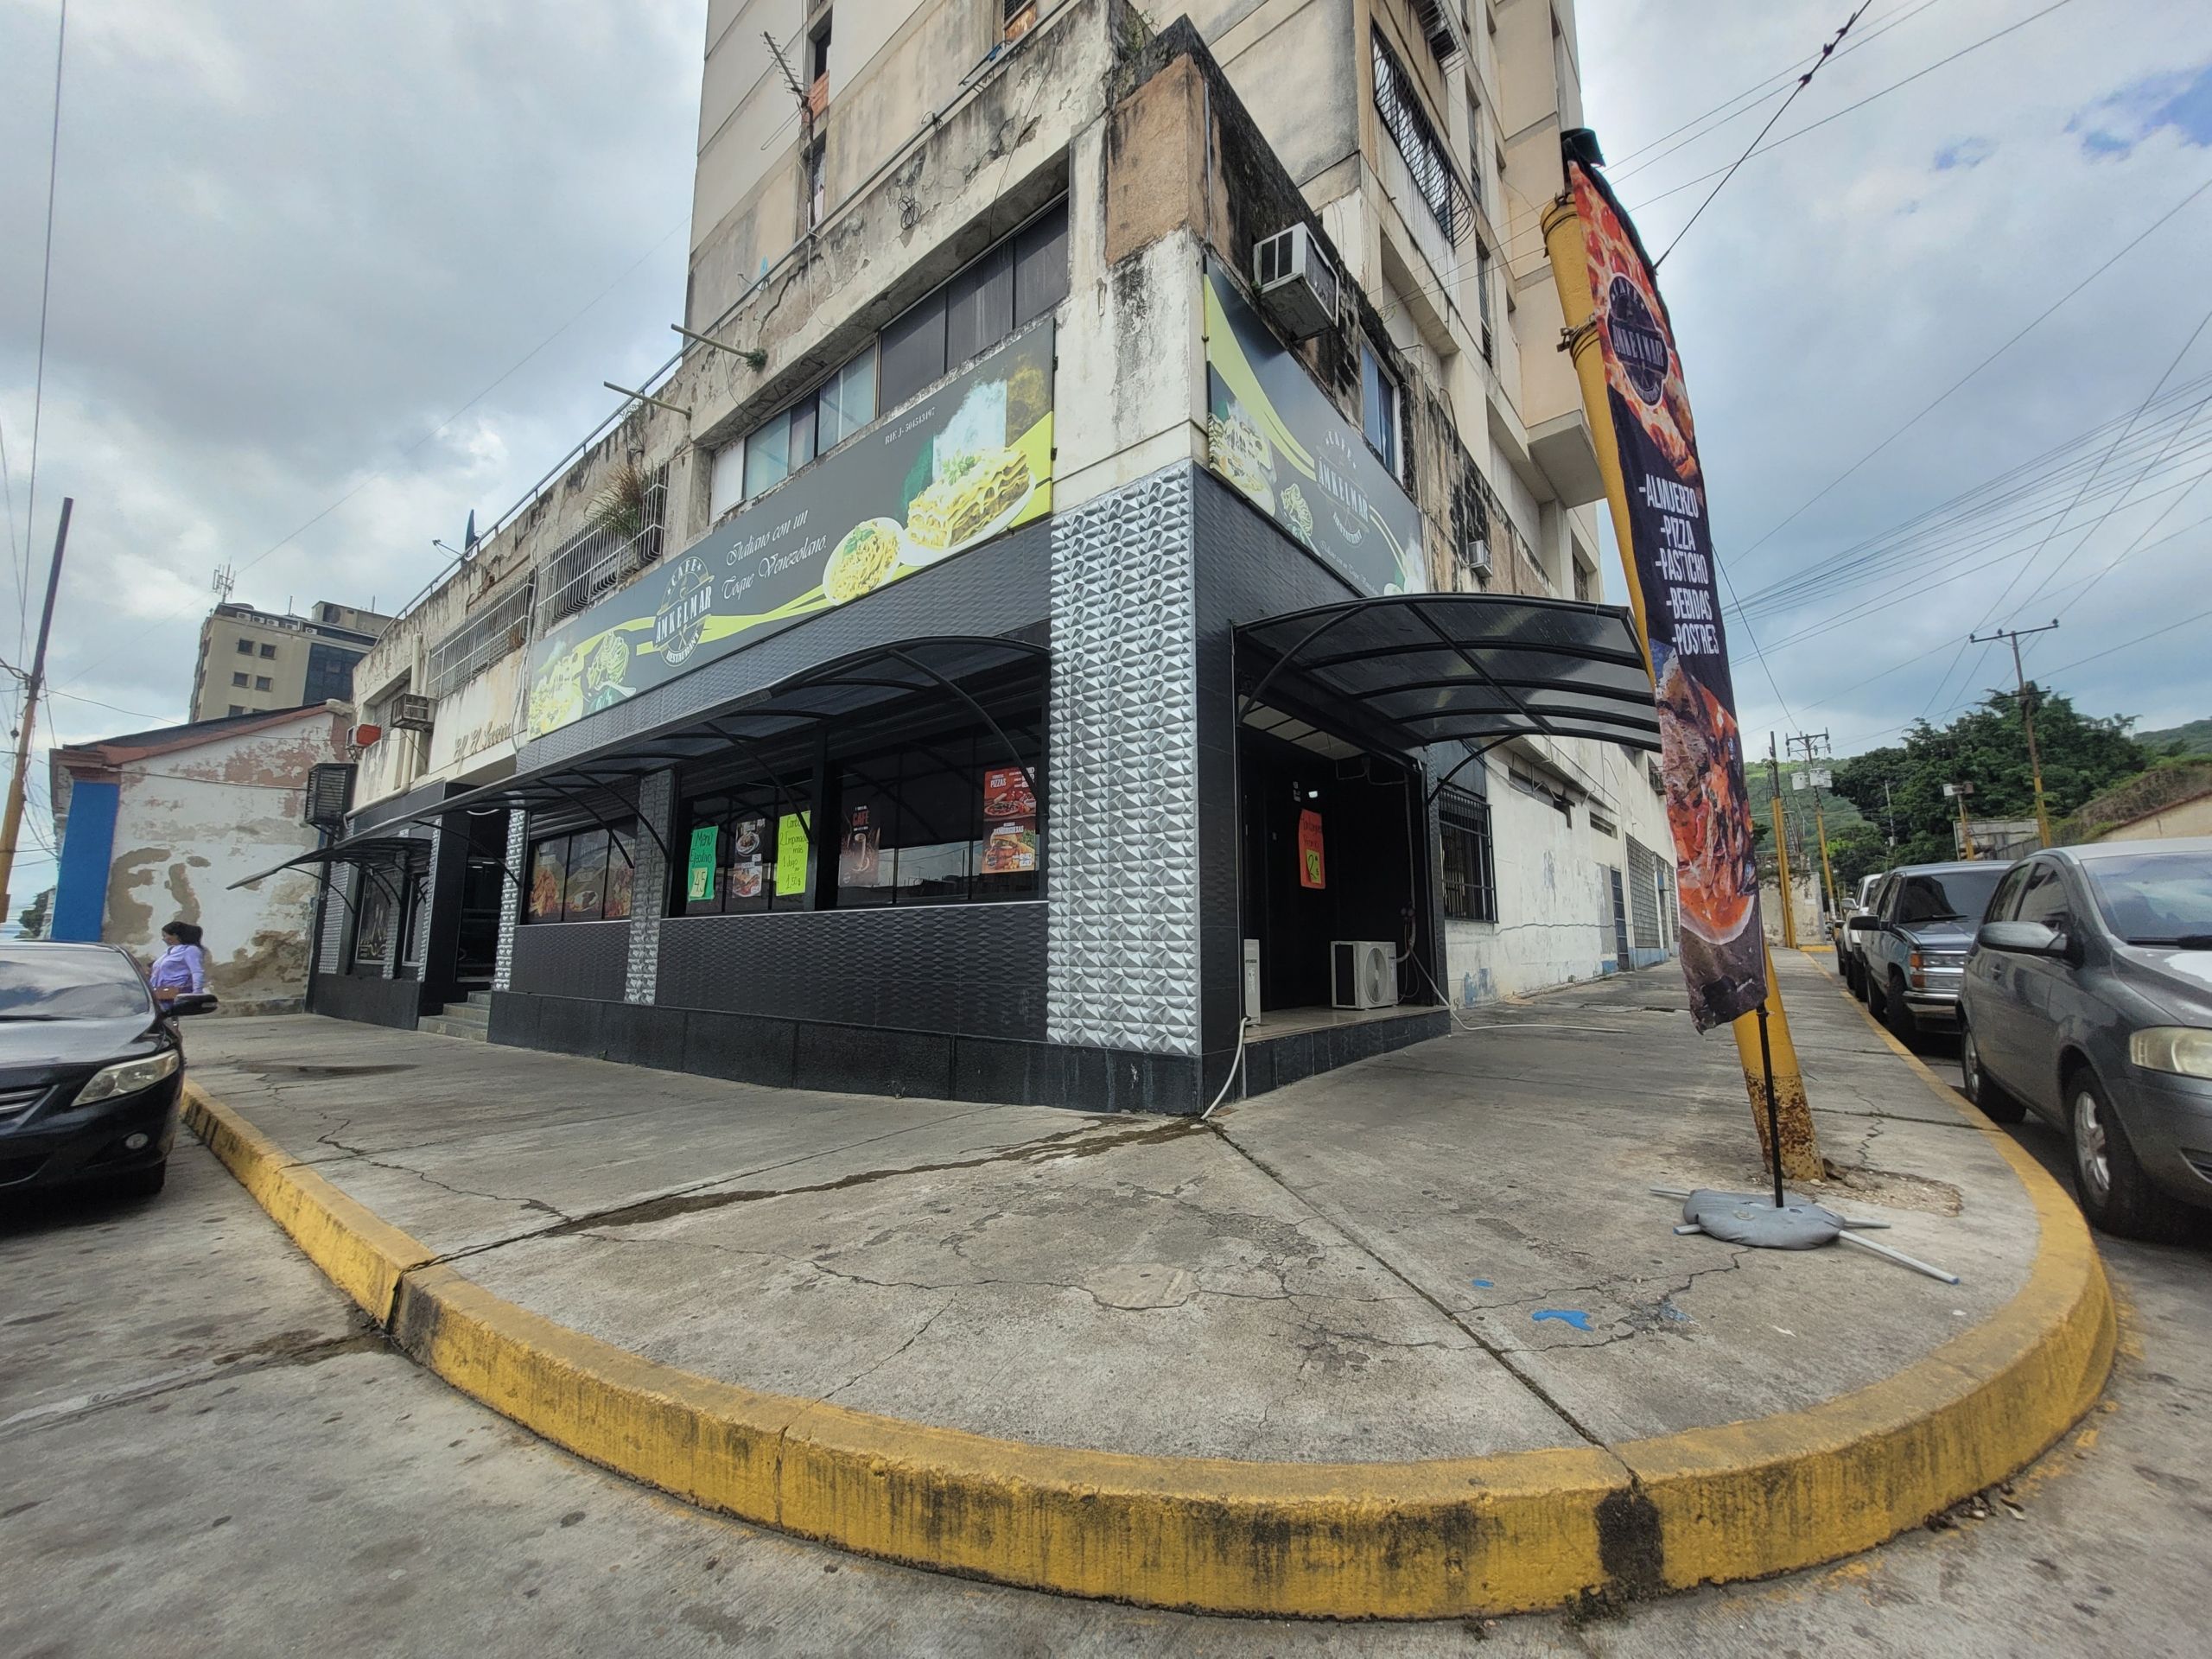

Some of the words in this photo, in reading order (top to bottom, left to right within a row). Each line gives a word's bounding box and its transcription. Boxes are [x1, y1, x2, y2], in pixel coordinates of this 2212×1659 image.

[1638, 474, 1699, 518] -ALMUERZO
[726, 531, 771, 566] Italiano
[772, 519, 791, 542] con
[792, 509, 809, 530] un
[1660, 515, 1696, 551] -PIZZA
[1655, 547, 1709, 585] -PASTICHO
[721, 573, 755, 601] Toque
[1665, 587, 1713, 621] -BEBIDAS
[990, 778, 1007, 788] PIZZAS
